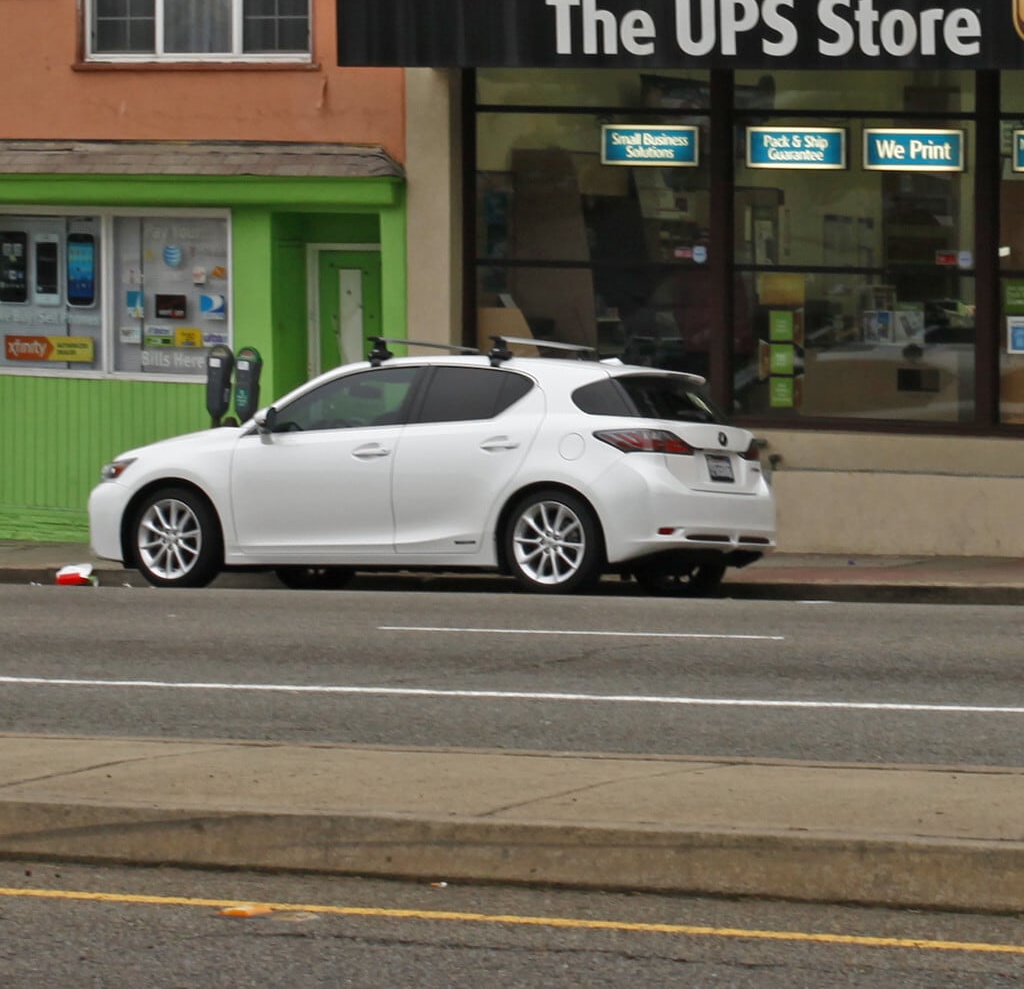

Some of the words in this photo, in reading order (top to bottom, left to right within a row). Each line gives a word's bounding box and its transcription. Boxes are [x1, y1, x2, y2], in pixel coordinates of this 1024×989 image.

[612, 132, 641, 146] Small
[643, 132, 689, 147] Business
[763, 134, 790, 148] Pack
[792, 134, 802, 148] &
[804, 134, 829, 151] Ship
[626, 146, 675, 159] Solutions
[768, 149, 825, 162] Guarantee
[875, 140, 905, 160] We
[910, 140, 952, 160] Print
[8, 339, 48, 357] xfinity
[142, 351, 170, 367] Bills
[174, 353, 206, 369] Here
